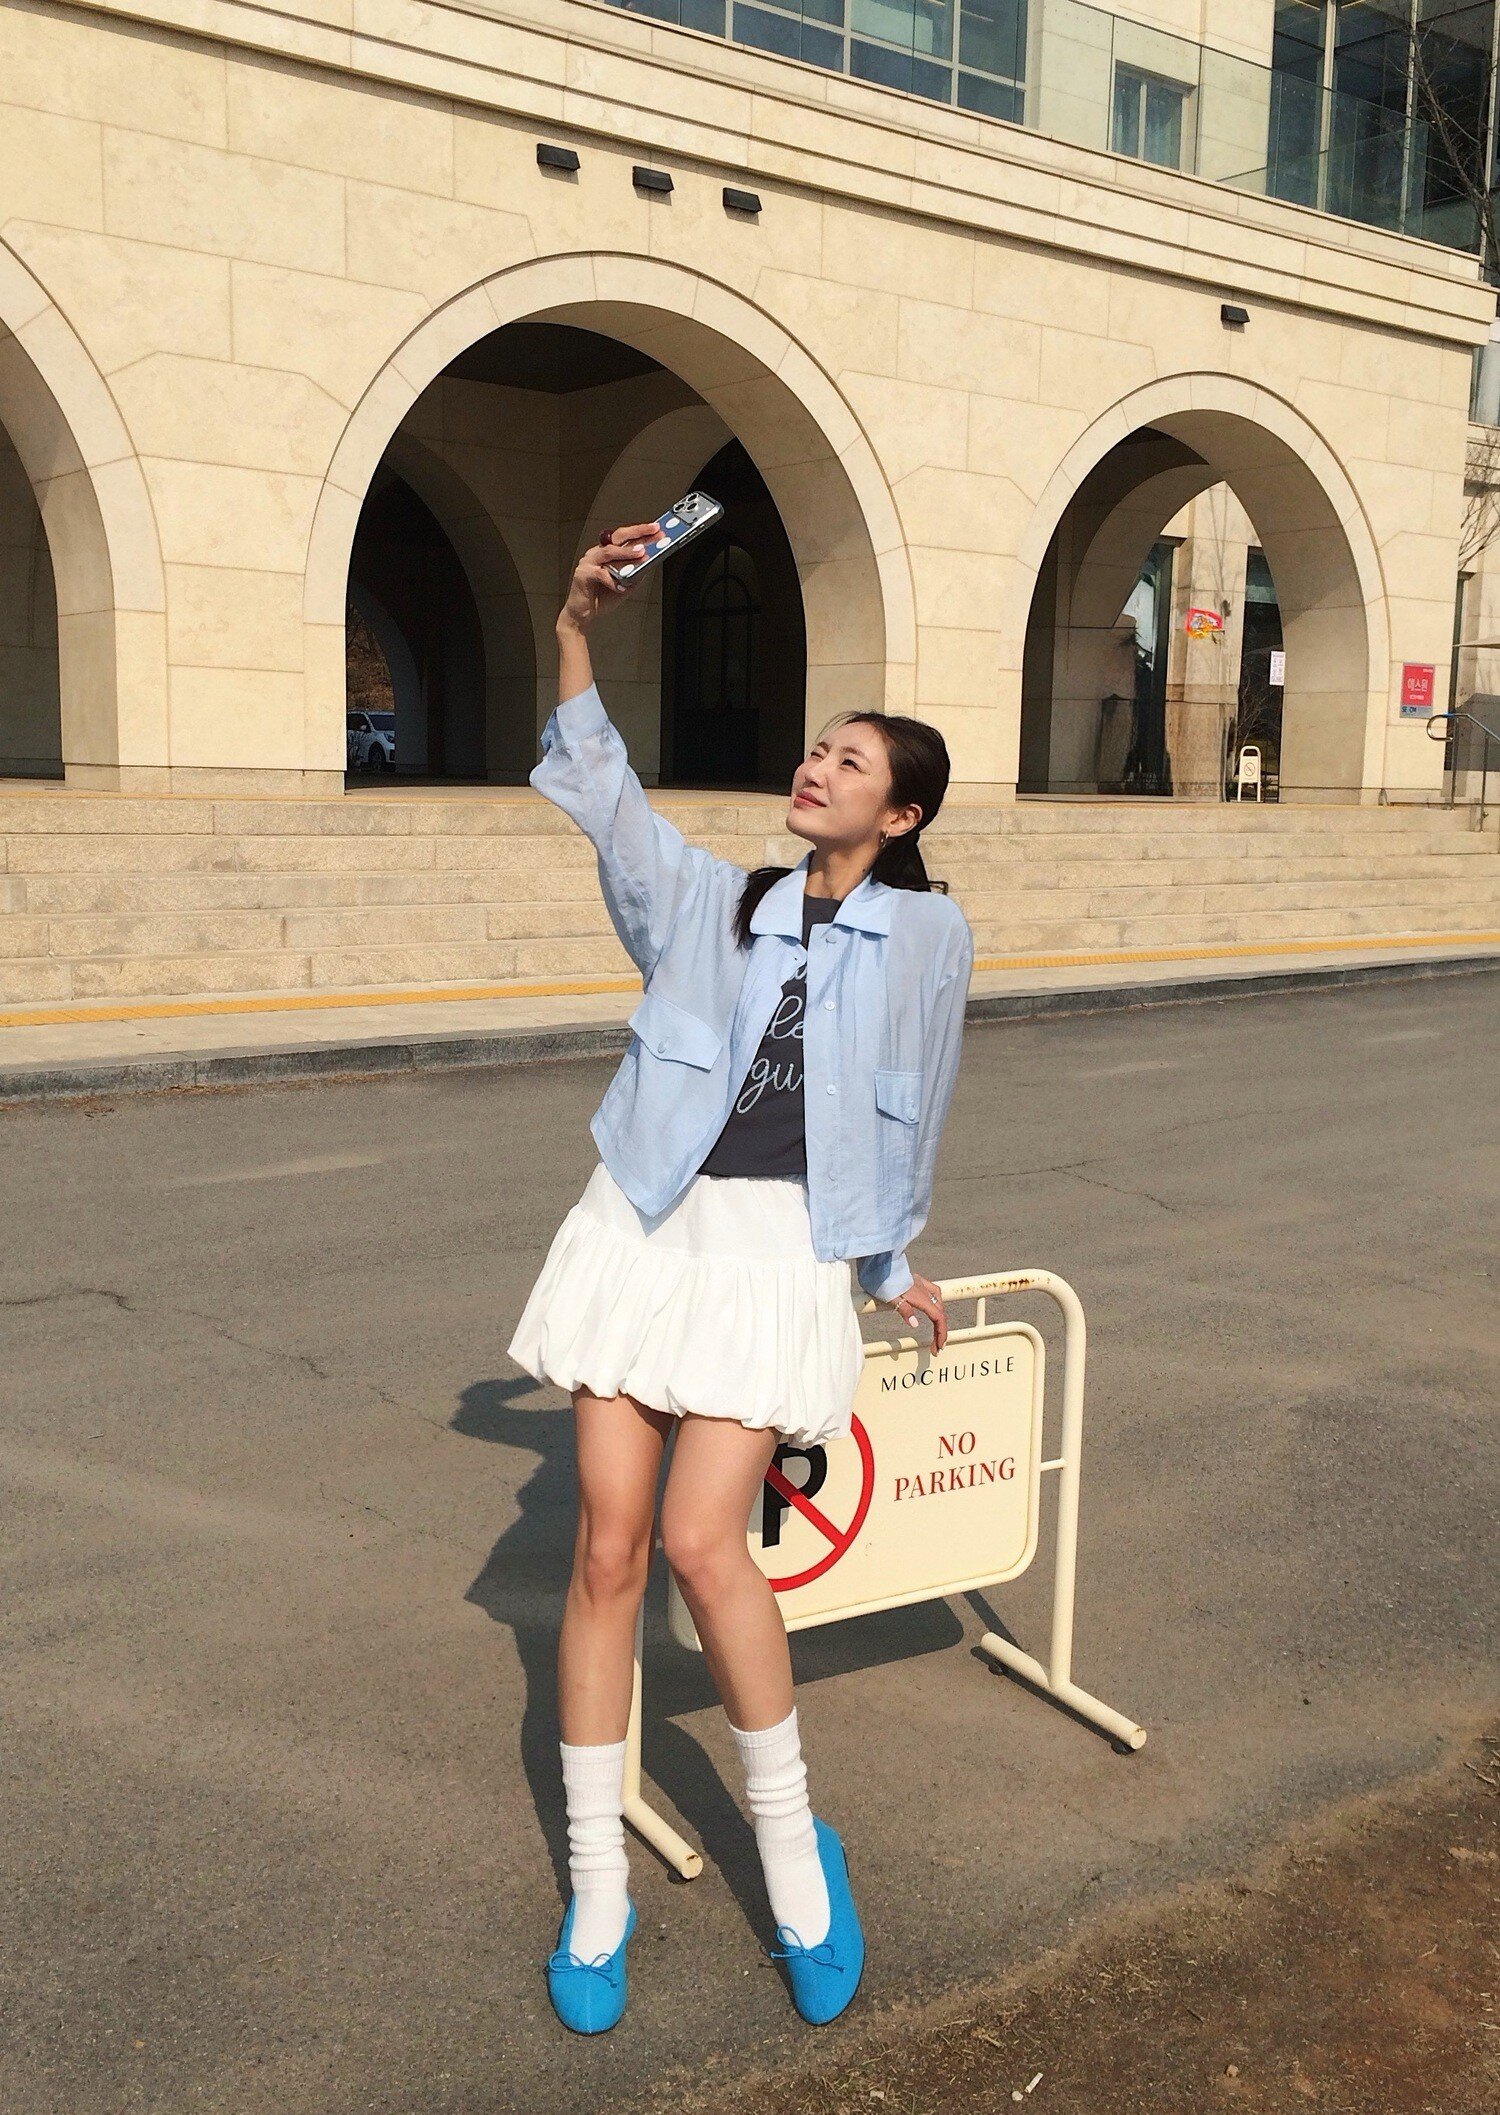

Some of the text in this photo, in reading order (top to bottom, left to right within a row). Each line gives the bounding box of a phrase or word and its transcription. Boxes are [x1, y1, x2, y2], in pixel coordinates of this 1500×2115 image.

[881, 1356, 1015, 1392] MOCHUISLE
[937, 1431, 976, 1459] NO
[762, 1442, 828, 1549] P
[893, 1457, 1016, 1501] PARKING
